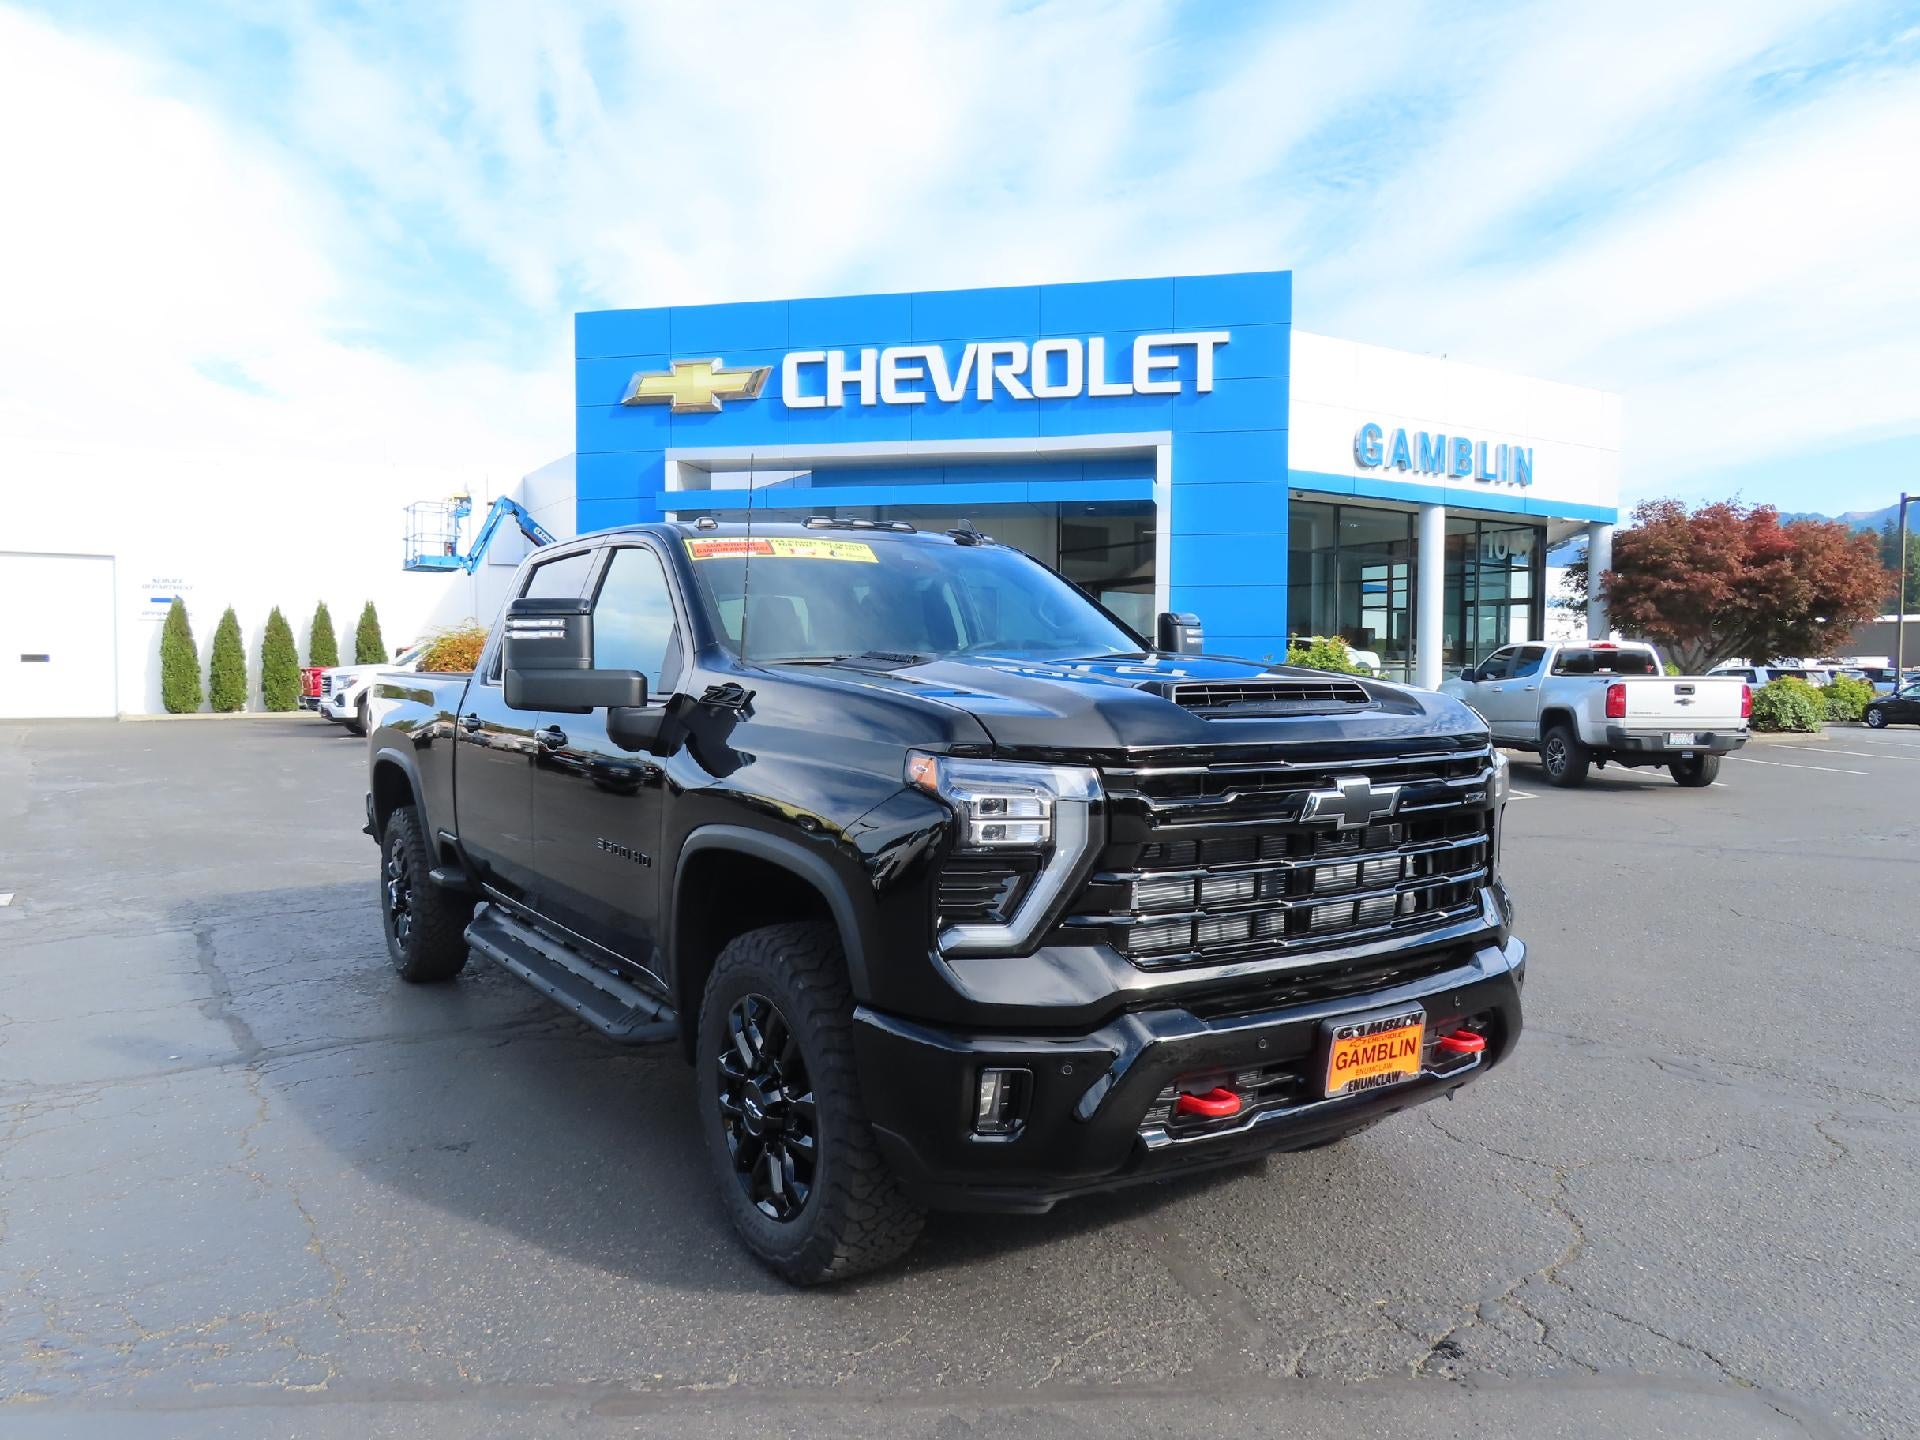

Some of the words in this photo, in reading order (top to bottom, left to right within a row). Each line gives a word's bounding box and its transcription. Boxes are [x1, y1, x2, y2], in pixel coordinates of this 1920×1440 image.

[782, 331, 1231, 408] CHEVROLET
[1353, 422, 1533, 487] GAMBLIN
[1337, 1012, 1422, 1040] GAMBLIN
[1367, 1031, 1406, 1044] CHEVROLET
[1335, 1037, 1417, 1071] GAMBLIN
[1347, 1070, 1400, 1093] ENUMCLAW
[1355, 1062, 1393, 1077] ENUMCLAW
